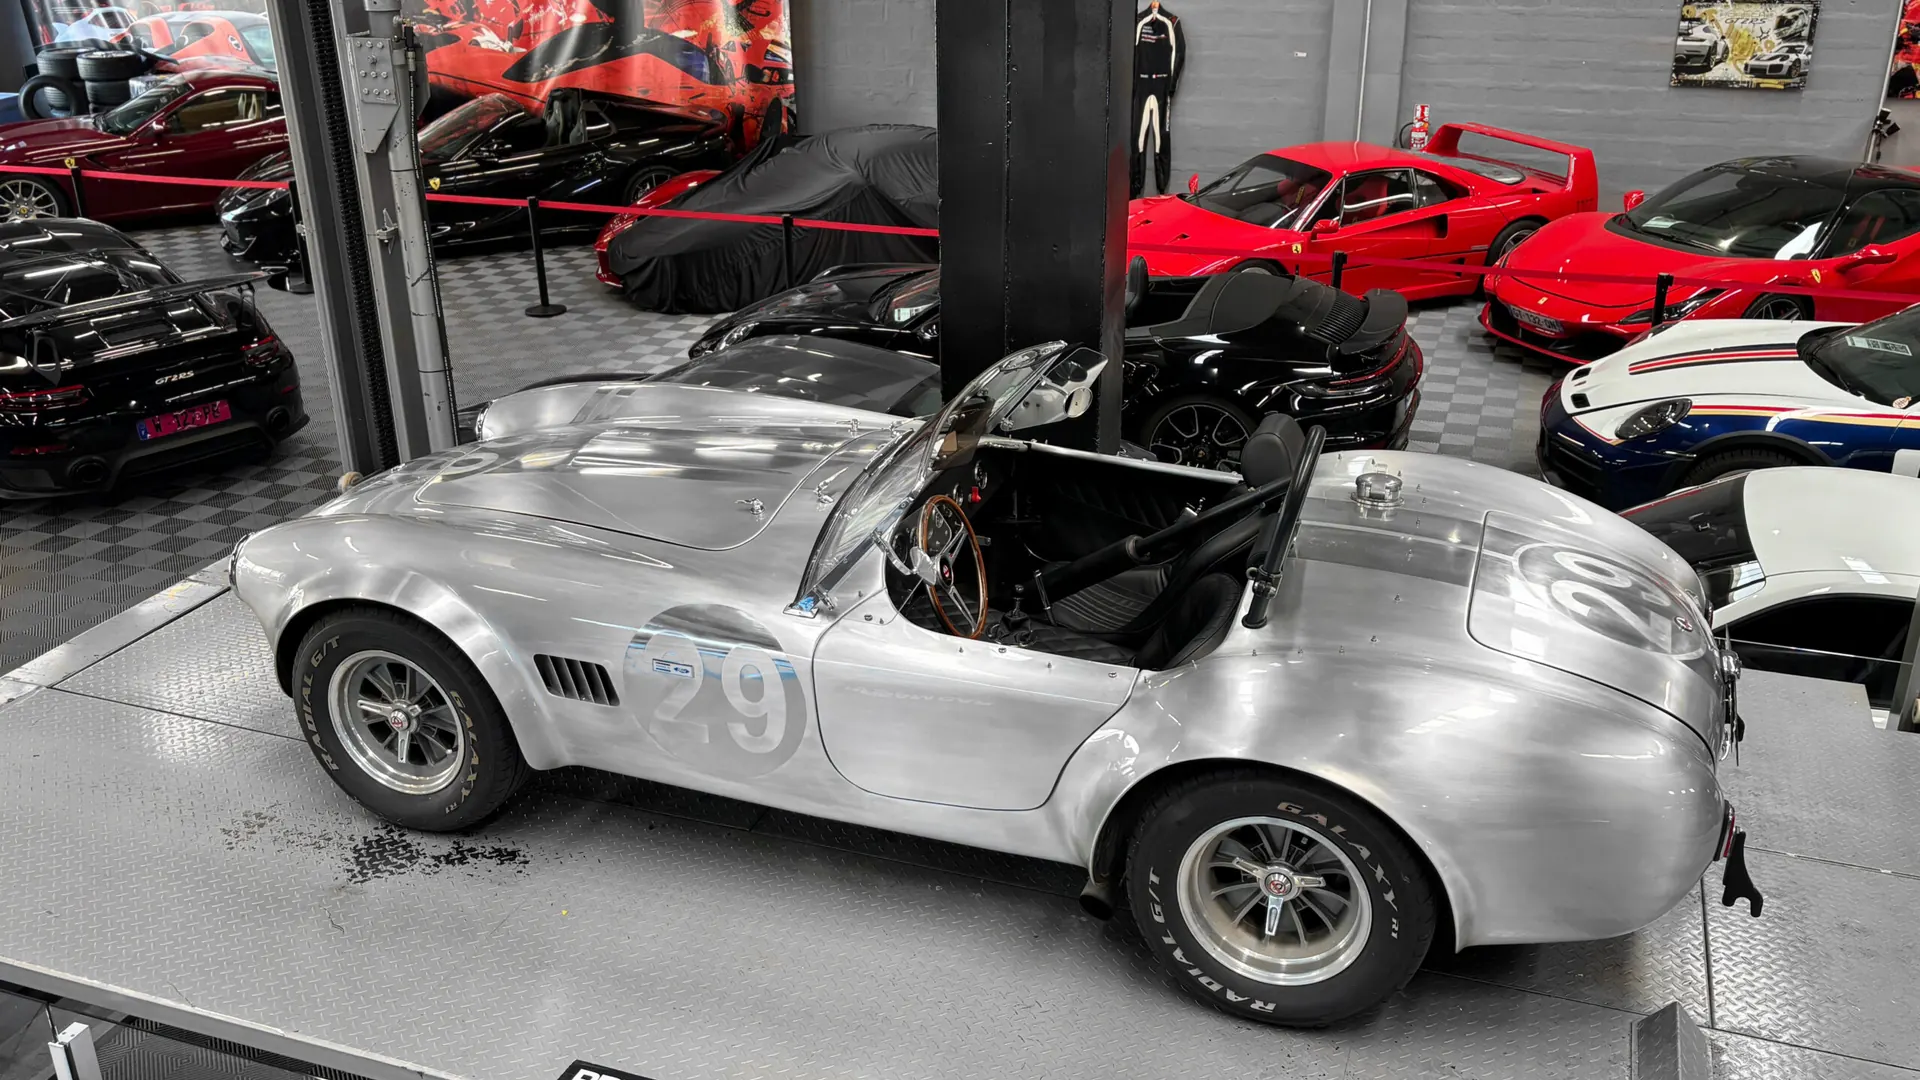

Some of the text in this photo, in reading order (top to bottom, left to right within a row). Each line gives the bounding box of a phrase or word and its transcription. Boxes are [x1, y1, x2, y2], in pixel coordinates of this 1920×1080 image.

[1550, 551, 1672, 655] 29
[302, 634, 340, 772] RADIAL G/T
[450, 690, 479, 804] GALAXY
[645, 629, 787, 754] 29
[1277, 801, 1399, 913] GALAXY
[1148, 866, 1277, 1013] RADIAL G/T
